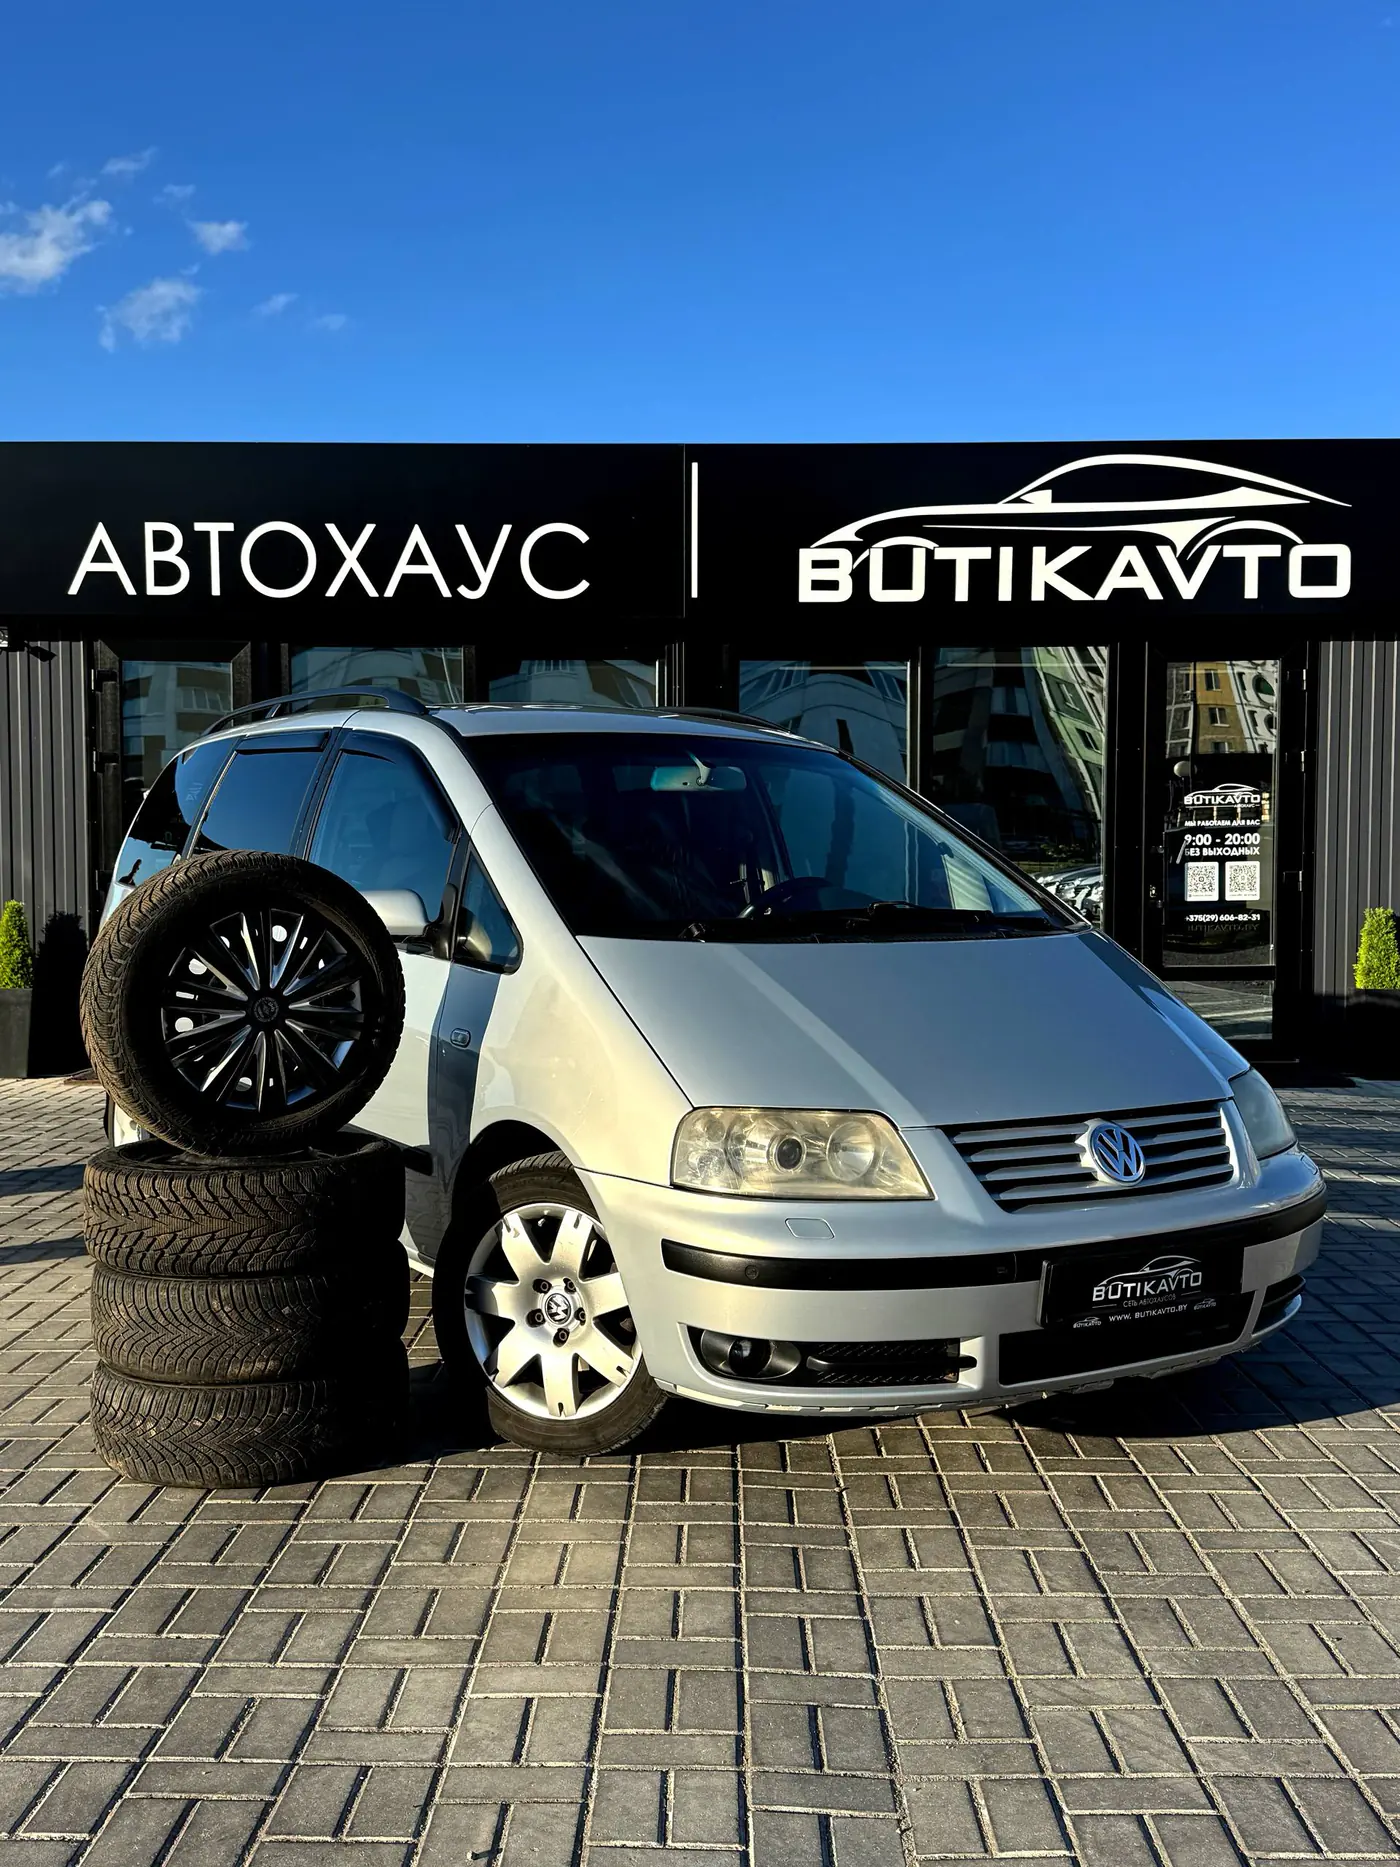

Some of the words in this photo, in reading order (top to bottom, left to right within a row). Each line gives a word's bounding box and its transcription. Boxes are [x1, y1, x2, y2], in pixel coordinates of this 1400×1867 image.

[67, 520, 590, 600] АВТОХАУС
[798, 543, 1352, 603] BUTIKAVTO
[1184, 794, 1261, 805] BUTIKAVTO
[1184, 833, 1212, 846] 9:00
[1224, 833, 1261, 845] 20:00
[1184, 848, 1201, 857] БЕЗ
[1202, 847, 1260, 856] ВЫХОДНЫХ
[1185, 914, 1219, 922] +375(29)
[1219, 914, 1261, 922] 606-82-31
[1092, 1271, 1202, 1302] BUTIKAVTO
